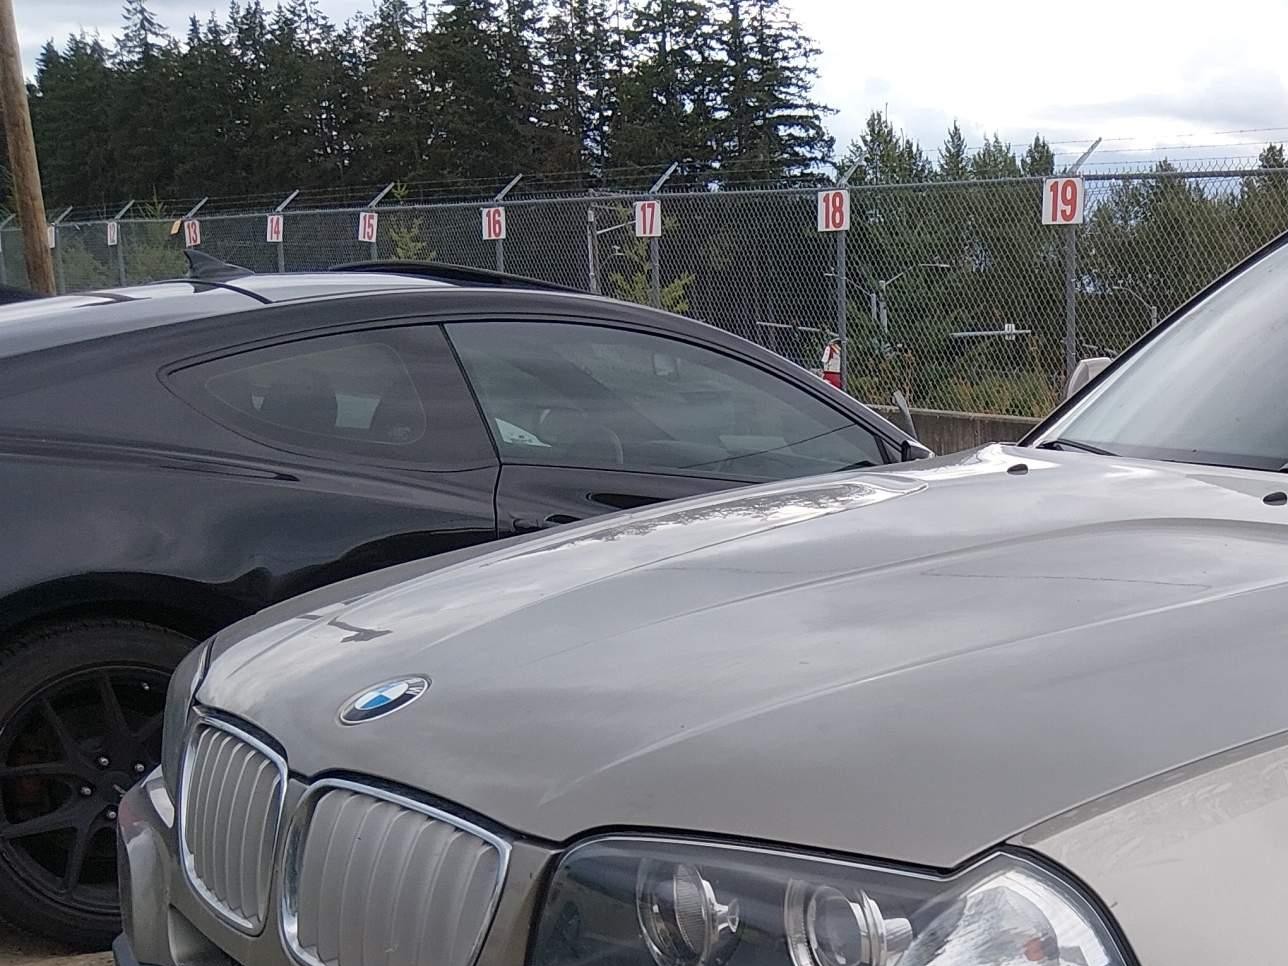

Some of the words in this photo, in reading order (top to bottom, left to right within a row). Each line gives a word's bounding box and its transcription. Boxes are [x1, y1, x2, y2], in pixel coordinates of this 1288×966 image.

[823, 191, 845, 230] 18
[1050, 180, 1078, 223] 19
[186, 222, 198, 244] 13
[269, 217, 281, 241] 14
[362, 214, 375, 241] 15
[485, 208, 502, 239] 16
[640, 202, 656, 235] 17
